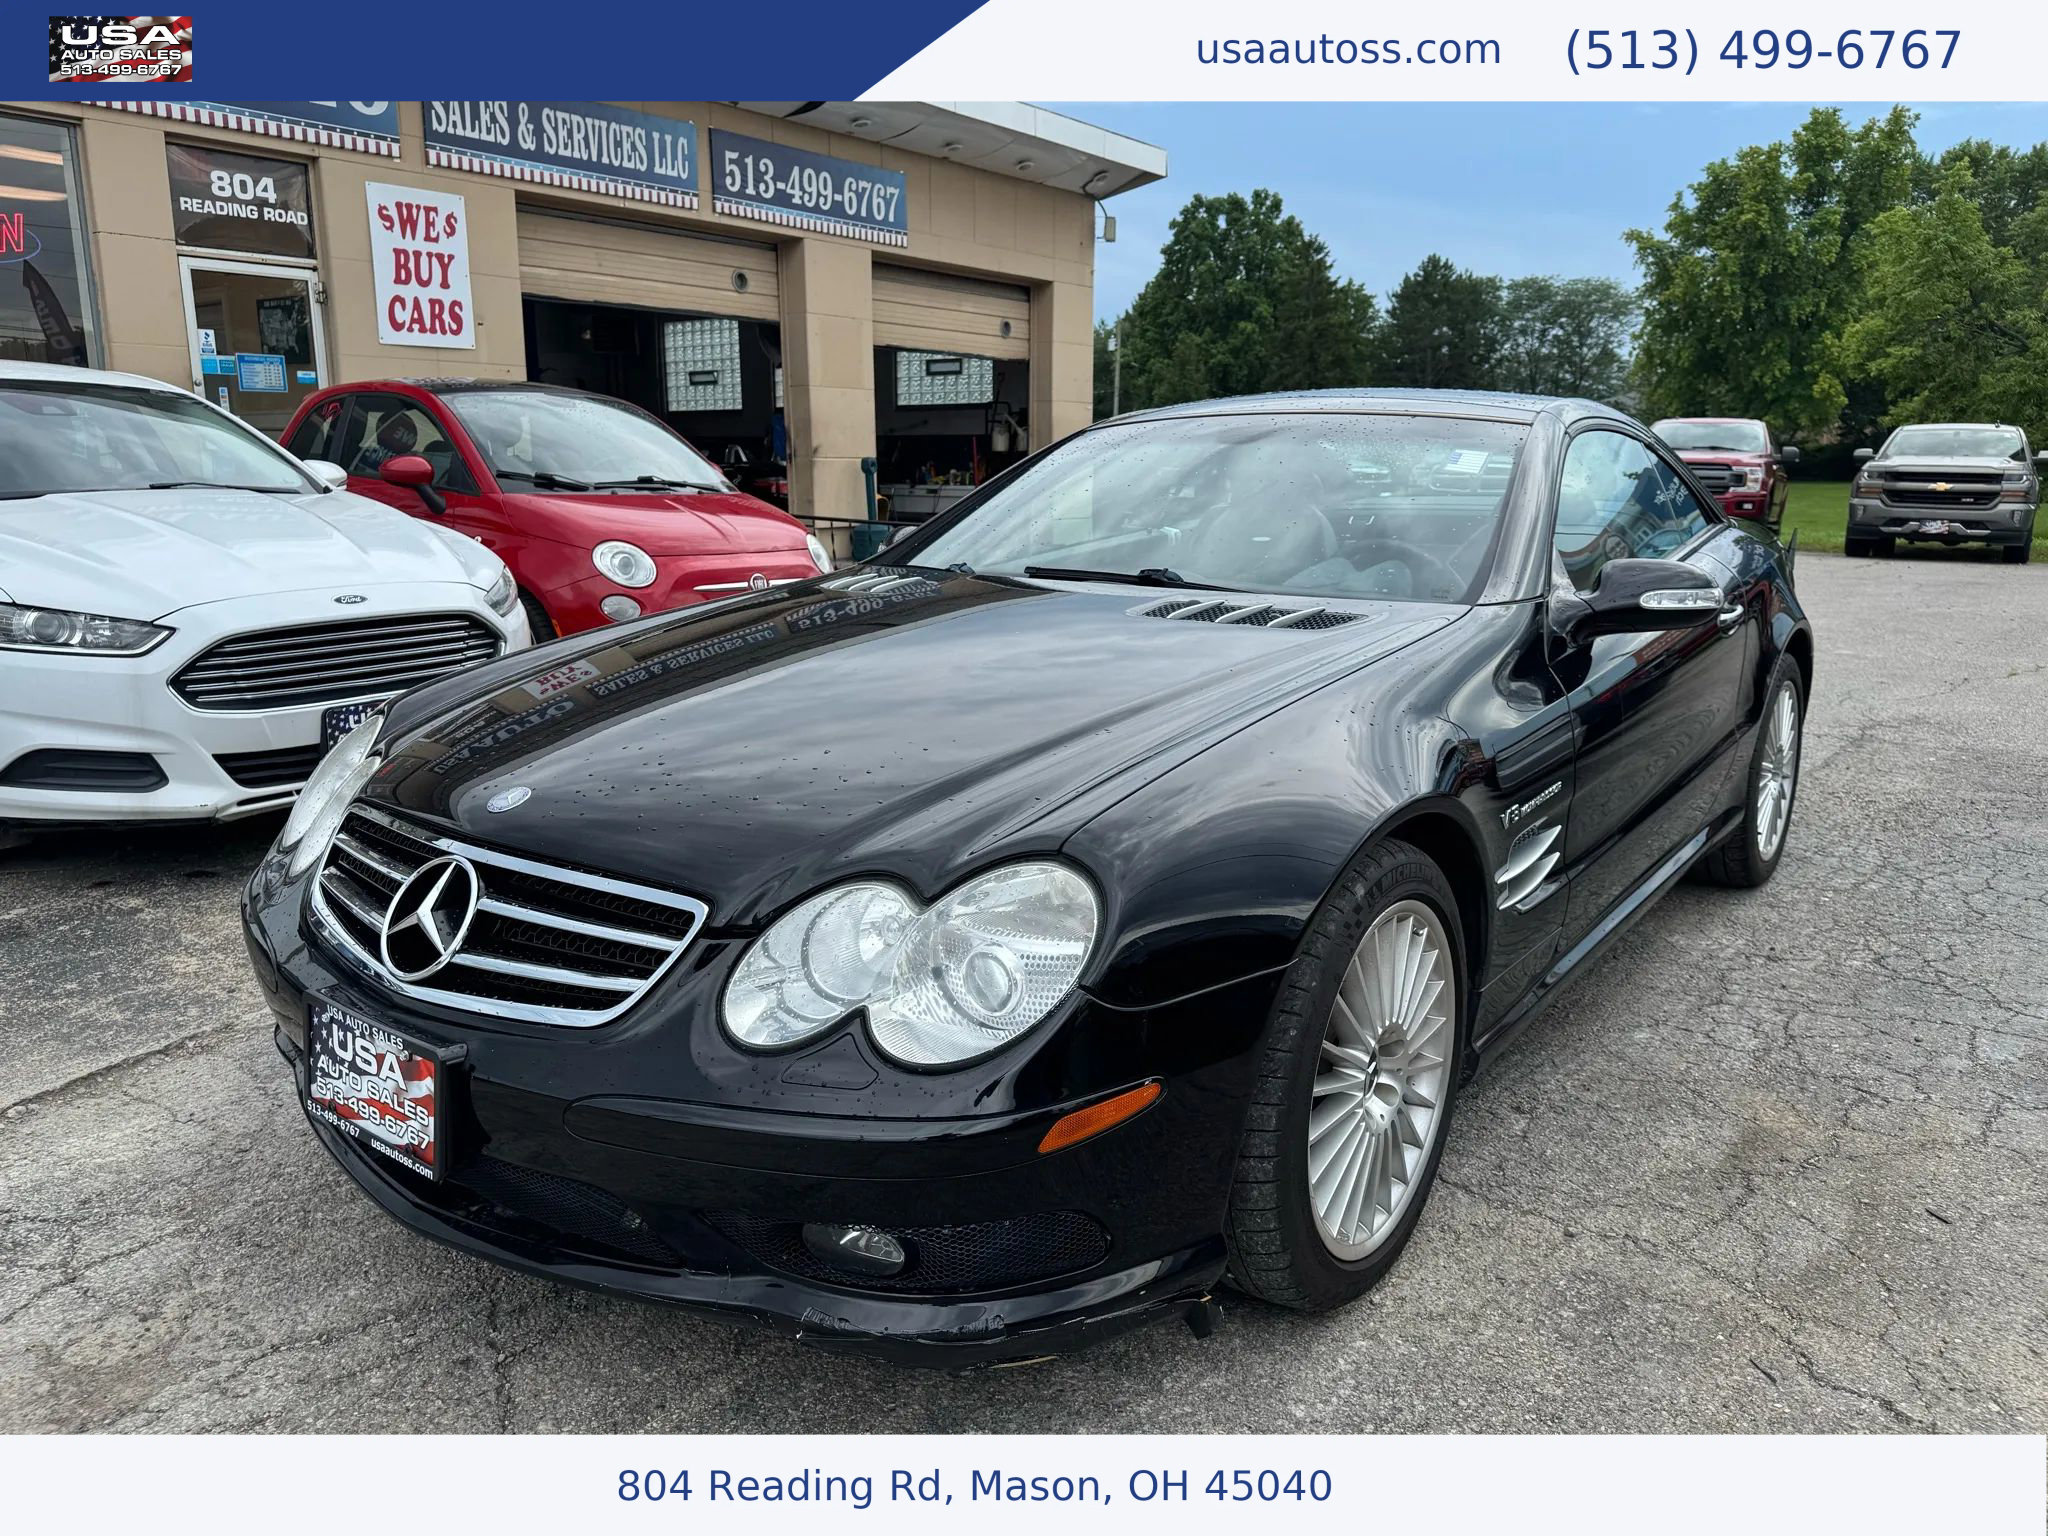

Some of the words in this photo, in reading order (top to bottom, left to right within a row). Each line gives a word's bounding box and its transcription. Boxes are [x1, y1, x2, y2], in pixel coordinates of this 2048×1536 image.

[431, 101, 510, 146] SALES
[517, 102, 536, 151] &
[541, 107, 648, 172] SERVICES
[652, 131, 689, 180] LLC
[210, 170, 277, 204] 804
[725, 150, 900, 223] 513-499-6767
[180, 197, 258, 219] READING
[263, 207, 309, 225] ROAD
[392, 247, 455, 289] BUY
[388, 294, 464, 336] CARS
[340, 594, 362, 603] Ford
[1499, 803, 1519, 830] V8
[327, 1004, 344, 1022] USA
[345, 1017, 370, 1036] AUTO
[372, 1027, 403, 1049] SALES
[332, 1023, 408, 1092] USA
[317, 1054, 361, 1091] AUTO
[367, 1079, 429, 1127] SALES
[307, 1100, 360, 1138] 513-499-6767
[316, 1076, 430, 1150] 513-499-6767
[371, 1138, 433, 1180] usaautoss.com
